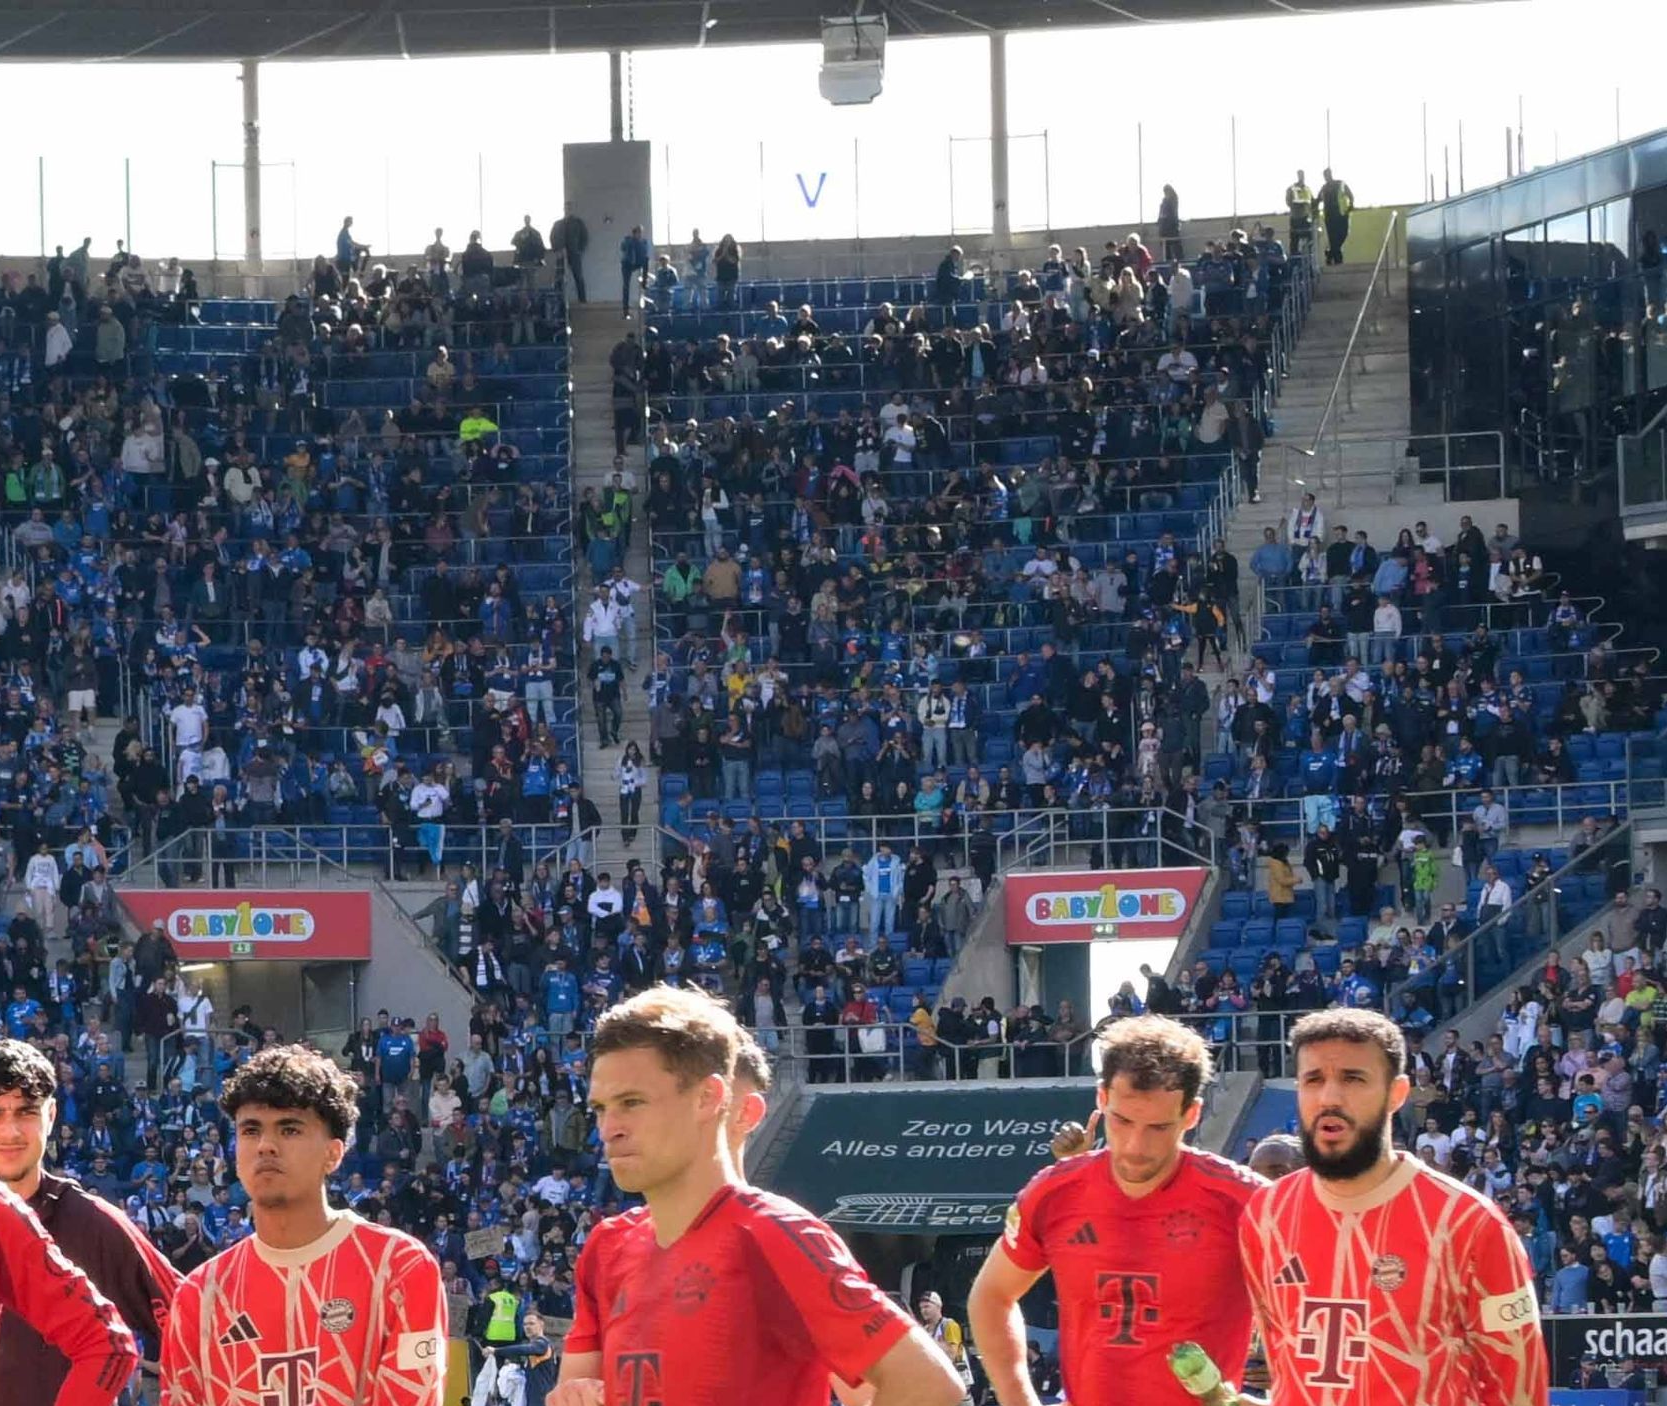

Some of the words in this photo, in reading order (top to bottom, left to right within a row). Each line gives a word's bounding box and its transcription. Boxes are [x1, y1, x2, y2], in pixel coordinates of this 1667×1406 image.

[795, 172, 827, 208] V
[902, 1118, 972, 1137] Zero
[983, 1117, 1065, 1136] Wast
[821, 1139, 898, 1157] Alles
[906, 1141, 1015, 1159] andere
[927, 1216, 1002, 1226] zero
